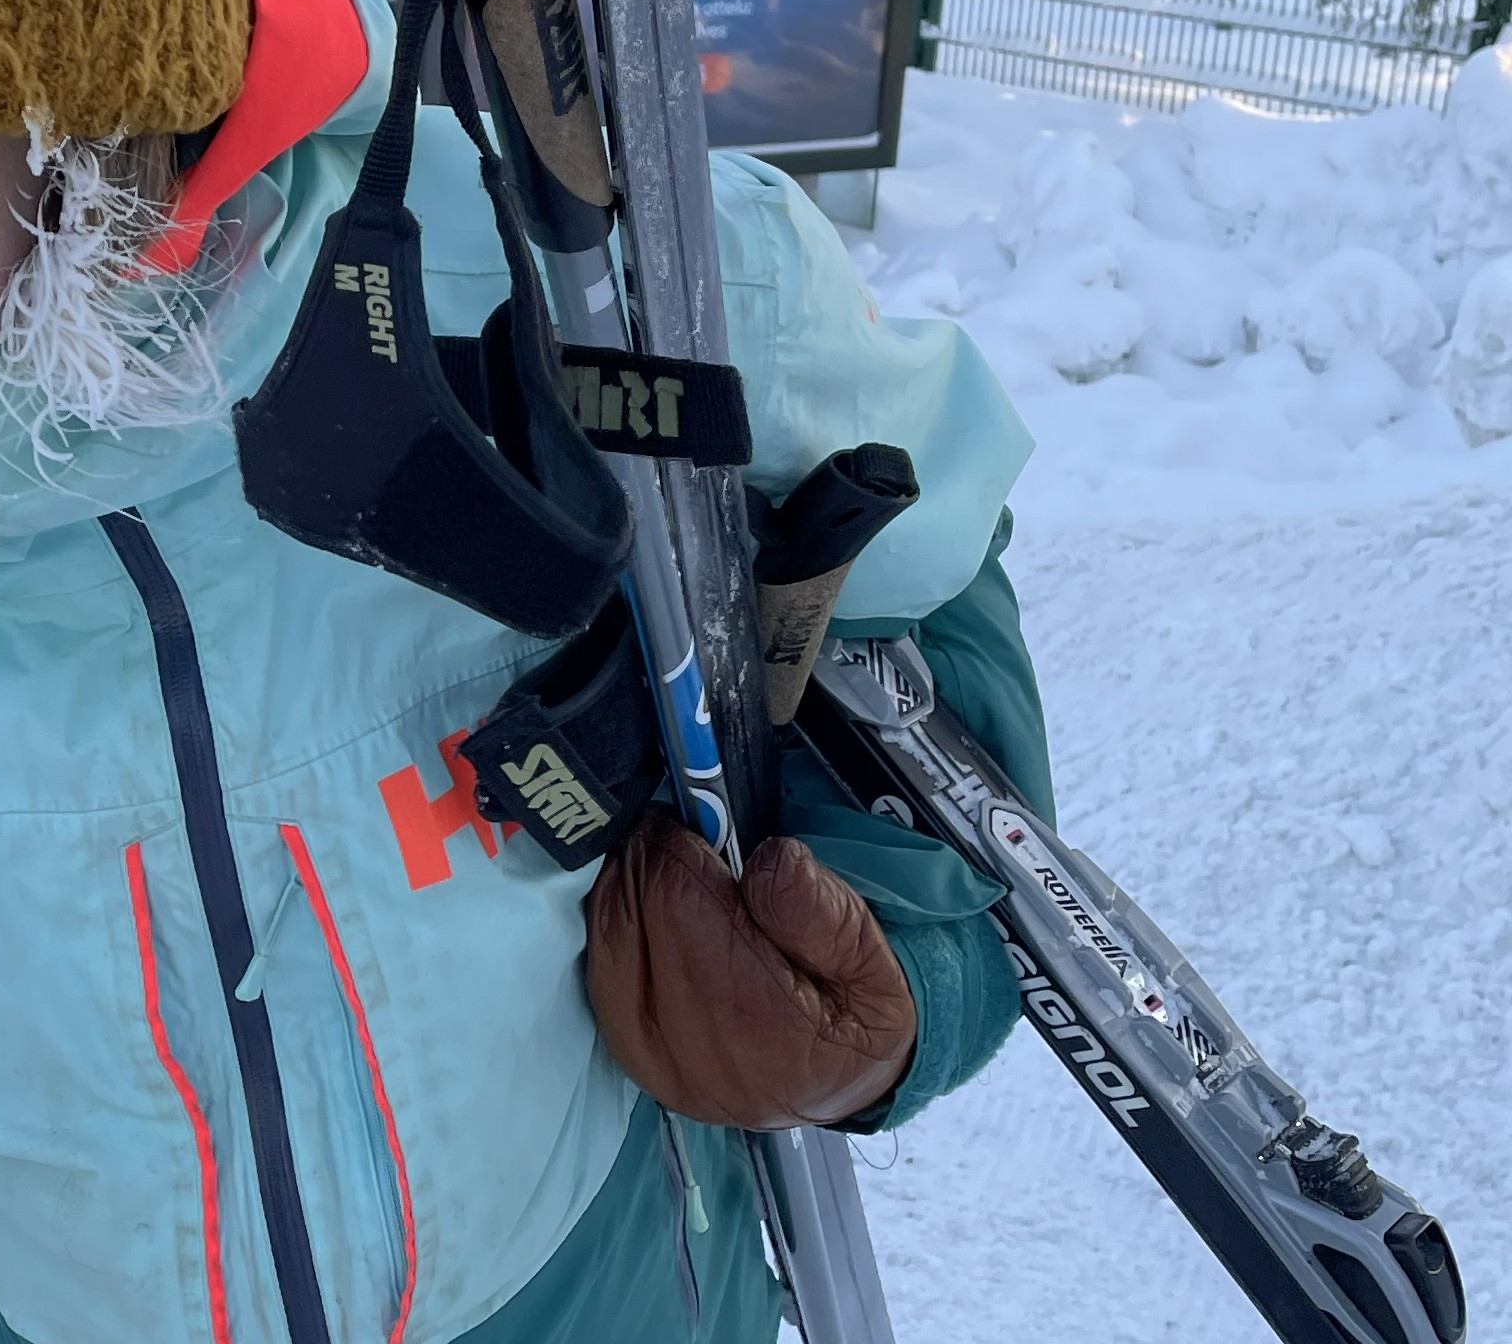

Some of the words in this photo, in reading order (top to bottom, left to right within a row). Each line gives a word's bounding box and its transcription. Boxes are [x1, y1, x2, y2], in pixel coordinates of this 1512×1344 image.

[333, 263, 360, 292] M
[363, 262, 398, 364] RIGHT
[499, 743, 615, 846] START
